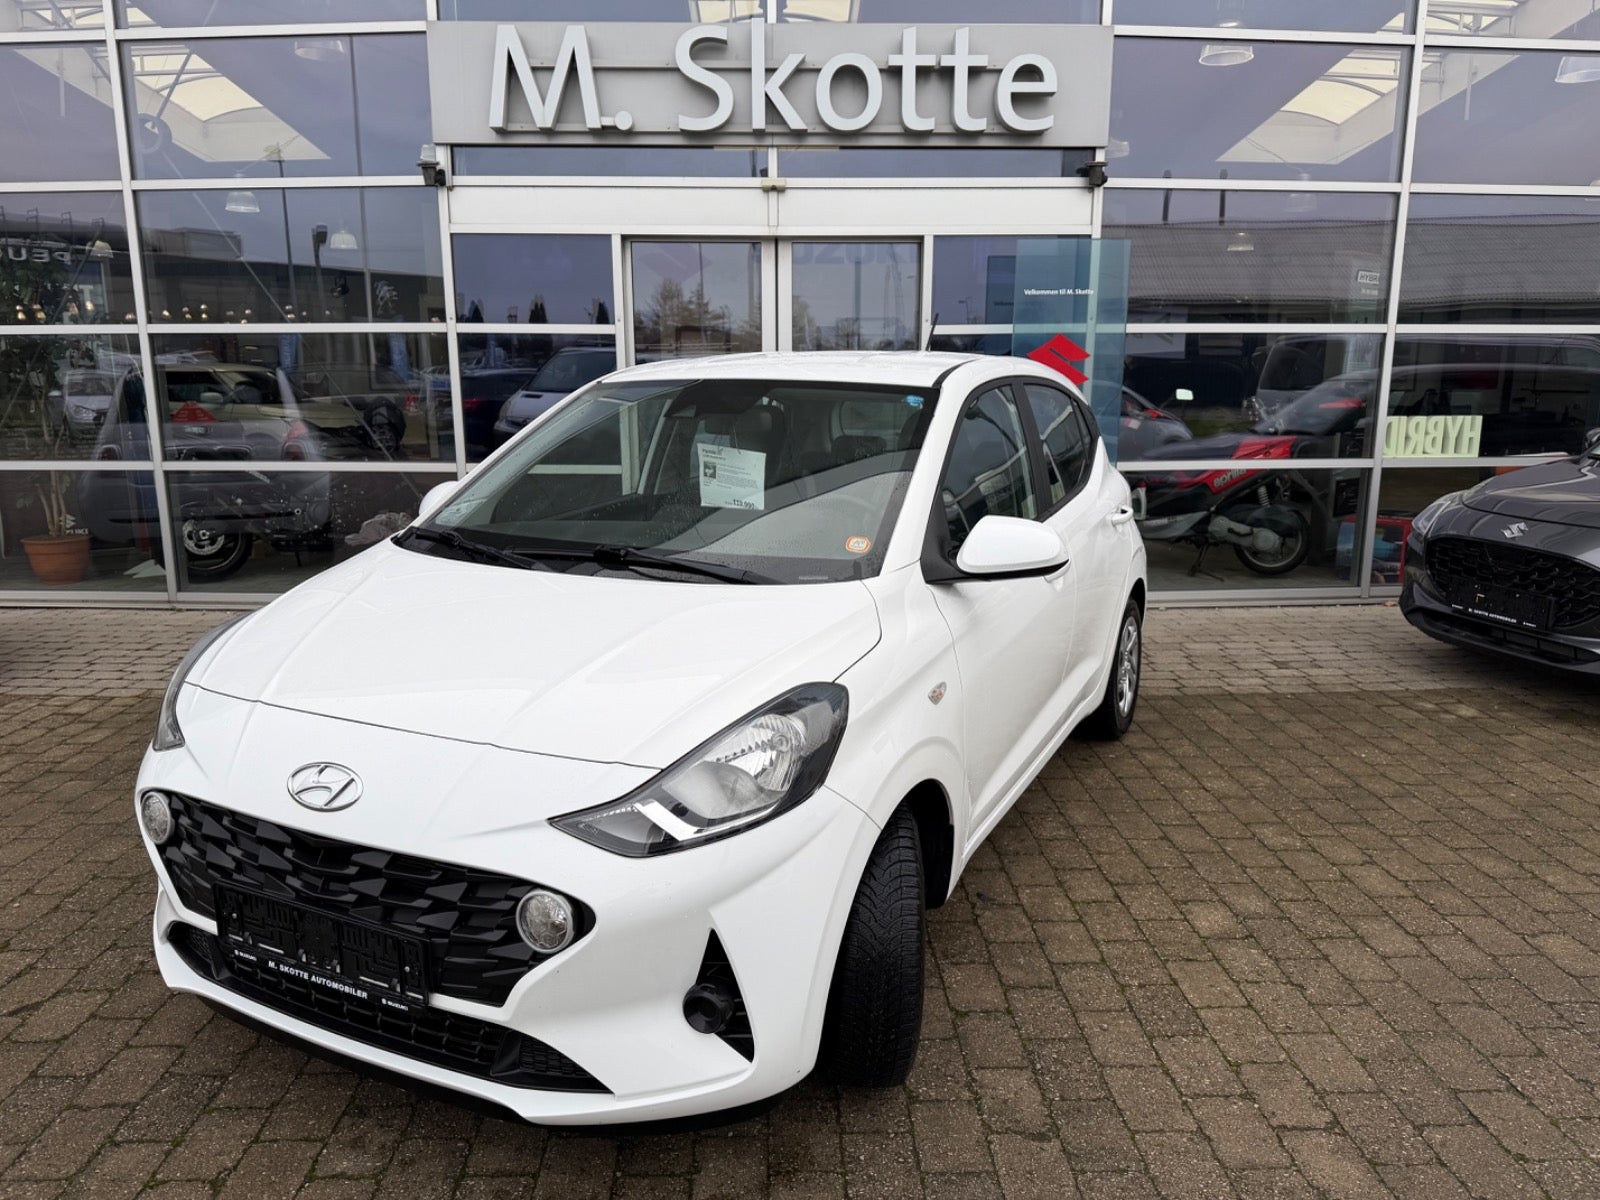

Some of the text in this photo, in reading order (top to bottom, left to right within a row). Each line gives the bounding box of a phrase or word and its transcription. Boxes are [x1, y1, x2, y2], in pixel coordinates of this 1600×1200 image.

[489, 17, 1058, 134] M. Skotte
[1024, 288, 1059, 296] Velkommen
[268, 960, 369, 1000] M. SKOTTE AUTOMOBILER
